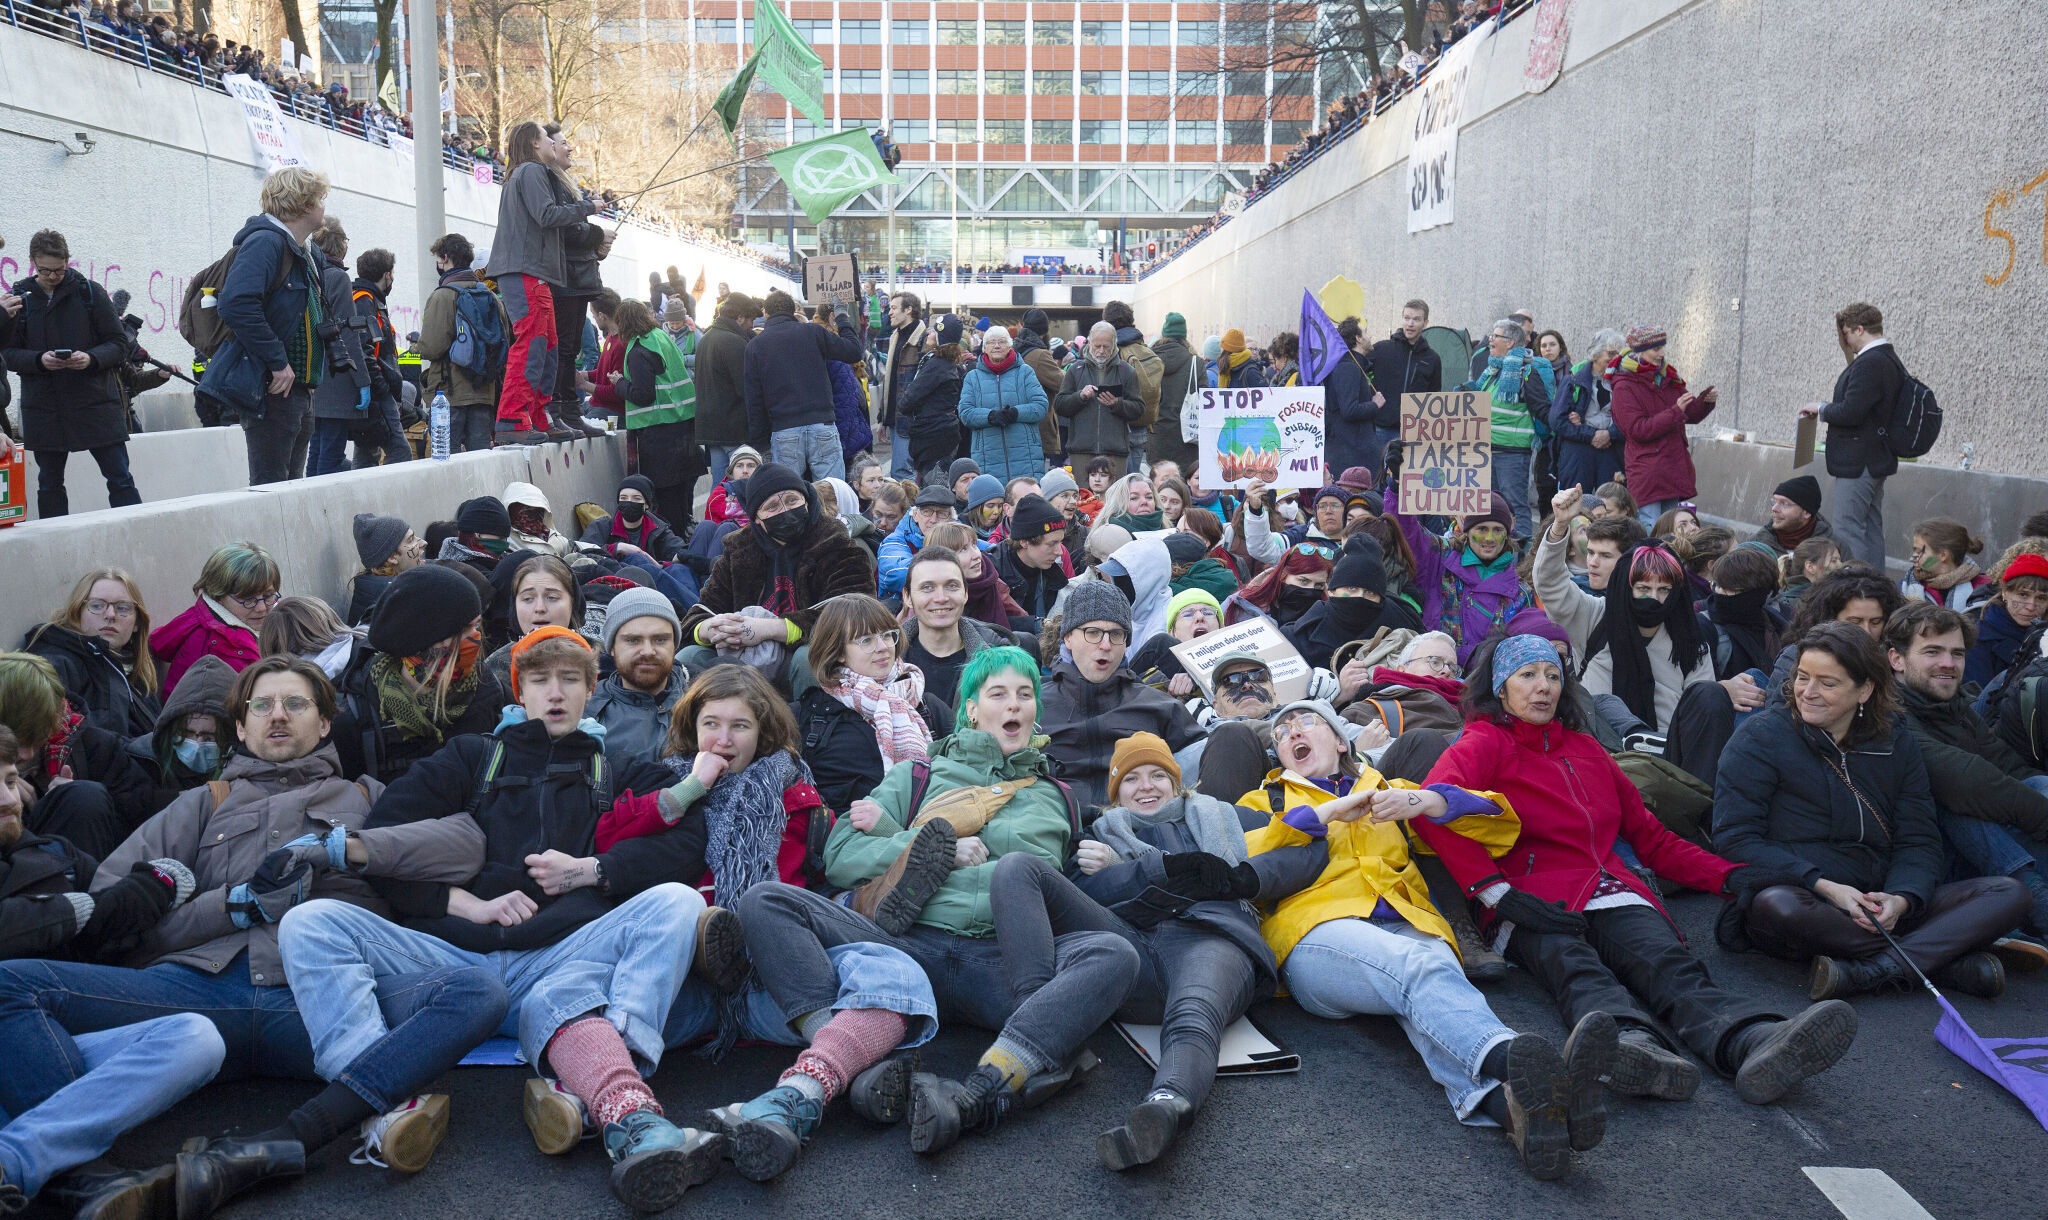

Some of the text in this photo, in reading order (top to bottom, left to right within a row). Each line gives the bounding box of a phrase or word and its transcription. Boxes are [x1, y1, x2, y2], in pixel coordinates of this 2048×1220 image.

[818, 265, 837, 282] 17
[1203, 389, 1263, 409] STOP
[1278, 401, 1324, 422] FOSSIELE
[1409, 393, 1477, 420] YOUR
[1284, 422, 1323, 449] SUBSIDIES
[1402, 414, 1488, 440] PROFIT
[1402, 441, 1489, 469] TAKES
[1401, 473, 1490, 512] FUTURE
[1187, 625, 1265, 660] 7 miljoen doden door
[1274, 659, 1298, 669] kinderen
